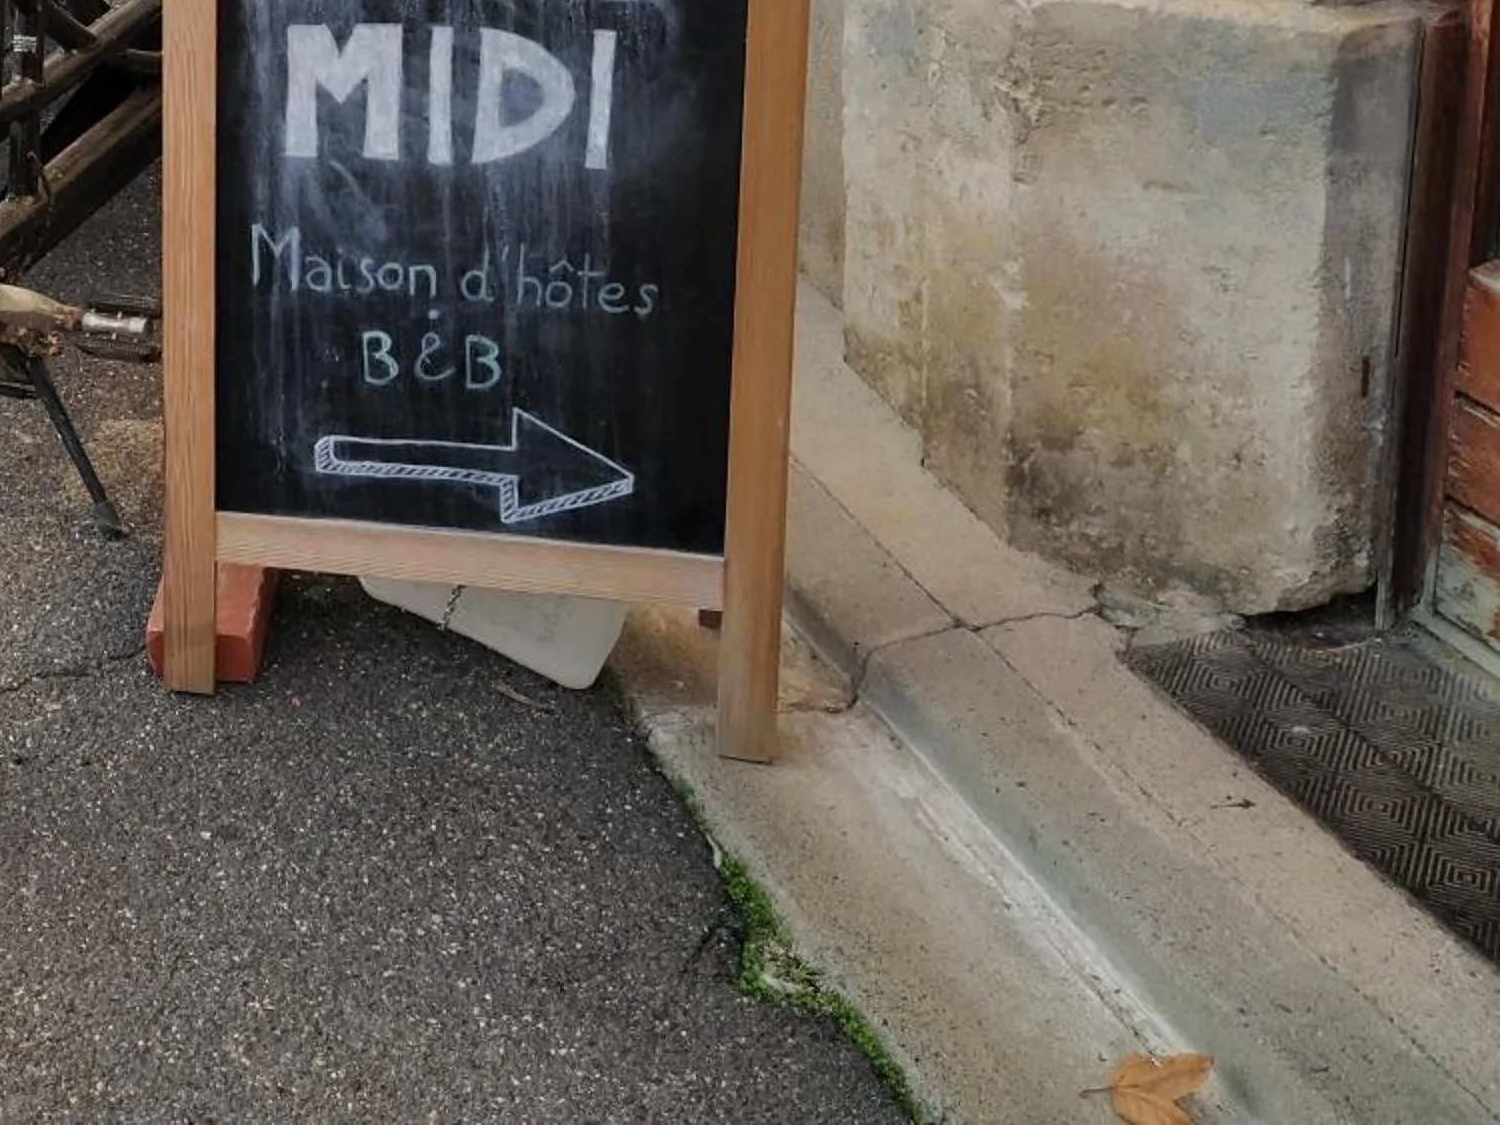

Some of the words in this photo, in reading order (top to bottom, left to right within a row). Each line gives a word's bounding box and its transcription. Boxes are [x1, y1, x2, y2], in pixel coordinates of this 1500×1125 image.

[285, 22, 617, 171] MIDI
[251, 222, 438, 300] Maison
[461, 241, 659, 320] d'hôtes
